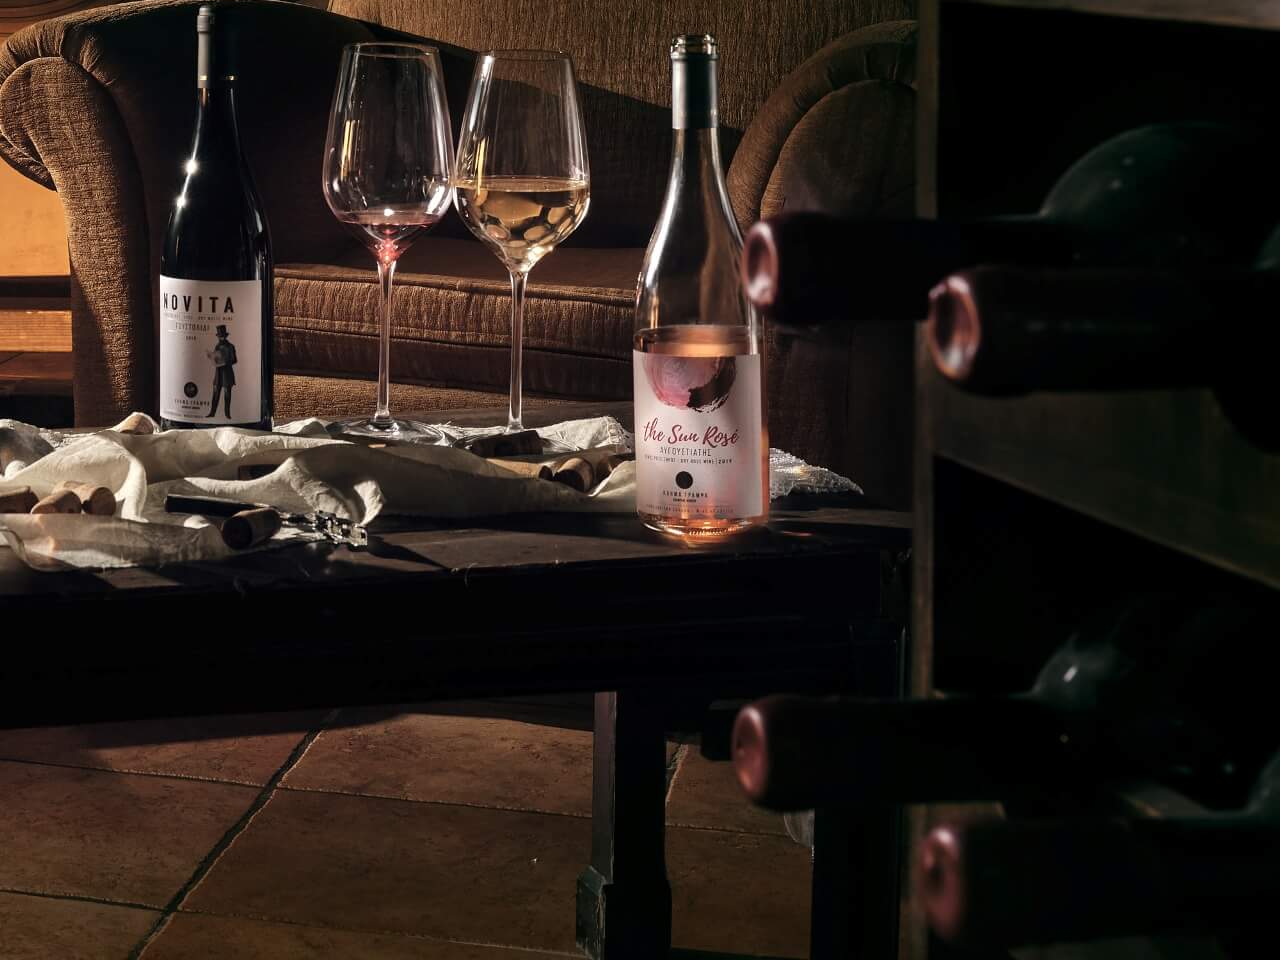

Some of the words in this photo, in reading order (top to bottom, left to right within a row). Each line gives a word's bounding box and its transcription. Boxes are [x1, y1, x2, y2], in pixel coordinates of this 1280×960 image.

[163, 292, 235, 314] NOVITA
[643, 417, 666, 442] the
[667, 424, 700, 445] Sun
[702, 426, 740, 448] Rosé
